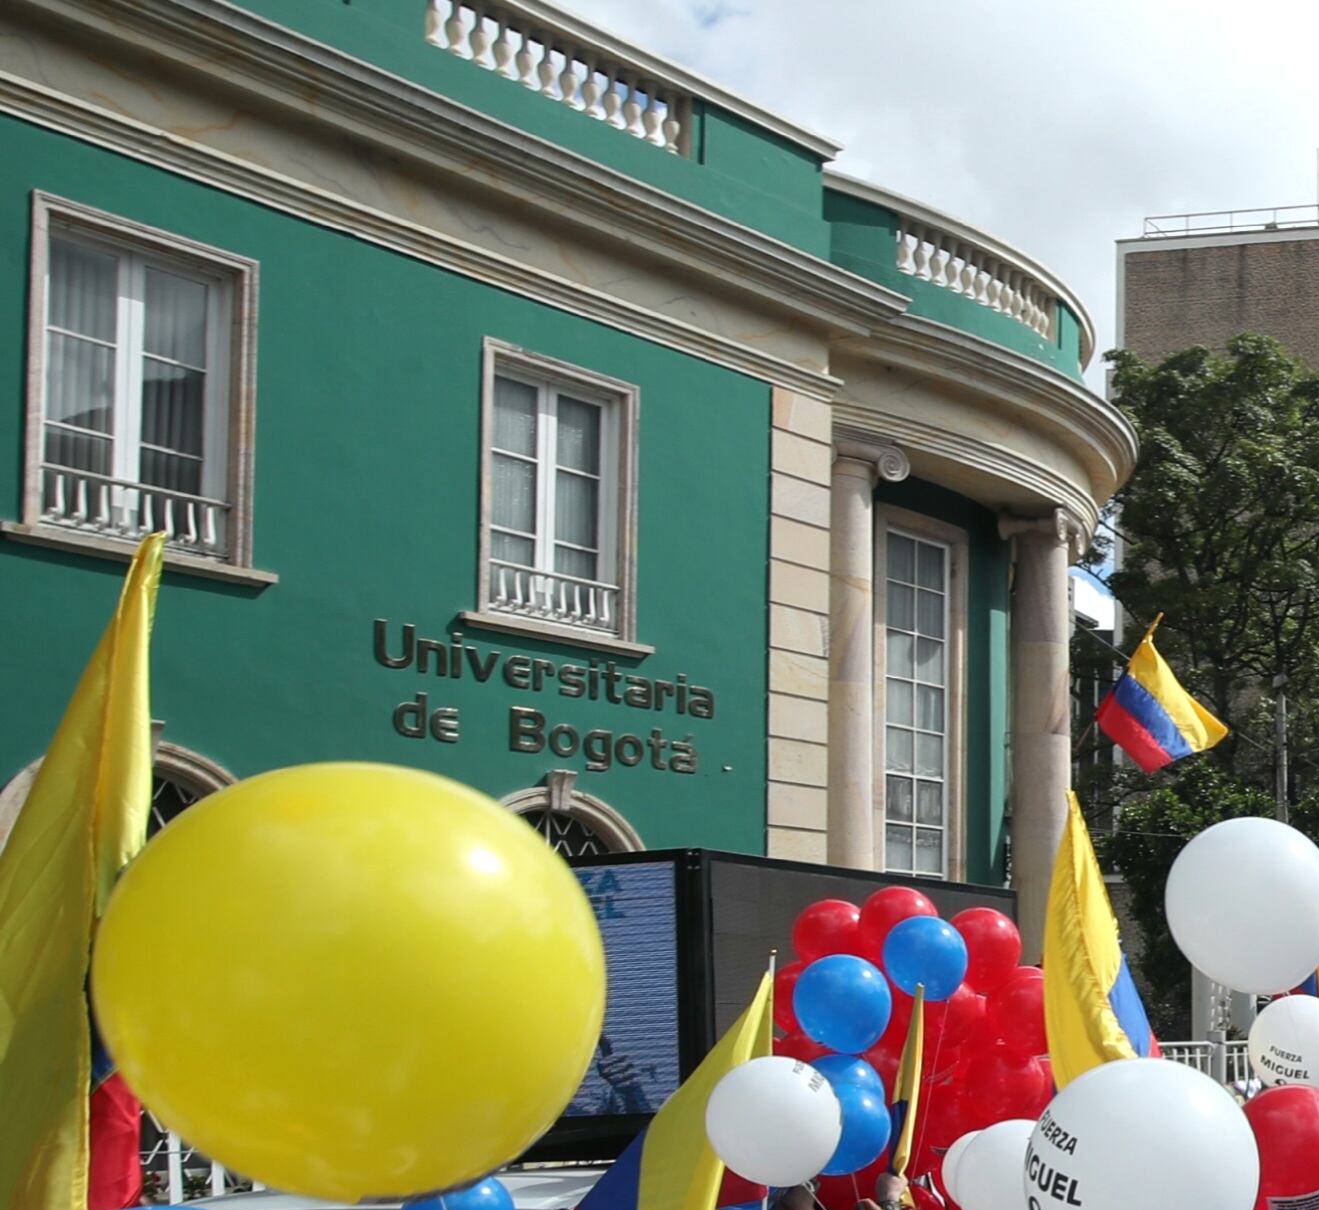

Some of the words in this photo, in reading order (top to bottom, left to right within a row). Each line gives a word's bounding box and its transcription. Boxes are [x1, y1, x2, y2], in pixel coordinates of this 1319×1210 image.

[374, 619, 715, 719] Universitaria
[393, 692, 460, 743] de
[508, 705, 697, 773] Bogotá
[1260, 1055, 1310, 1080] MIGUEL
[1269, 1045, 1303, 1063] FUERZA
